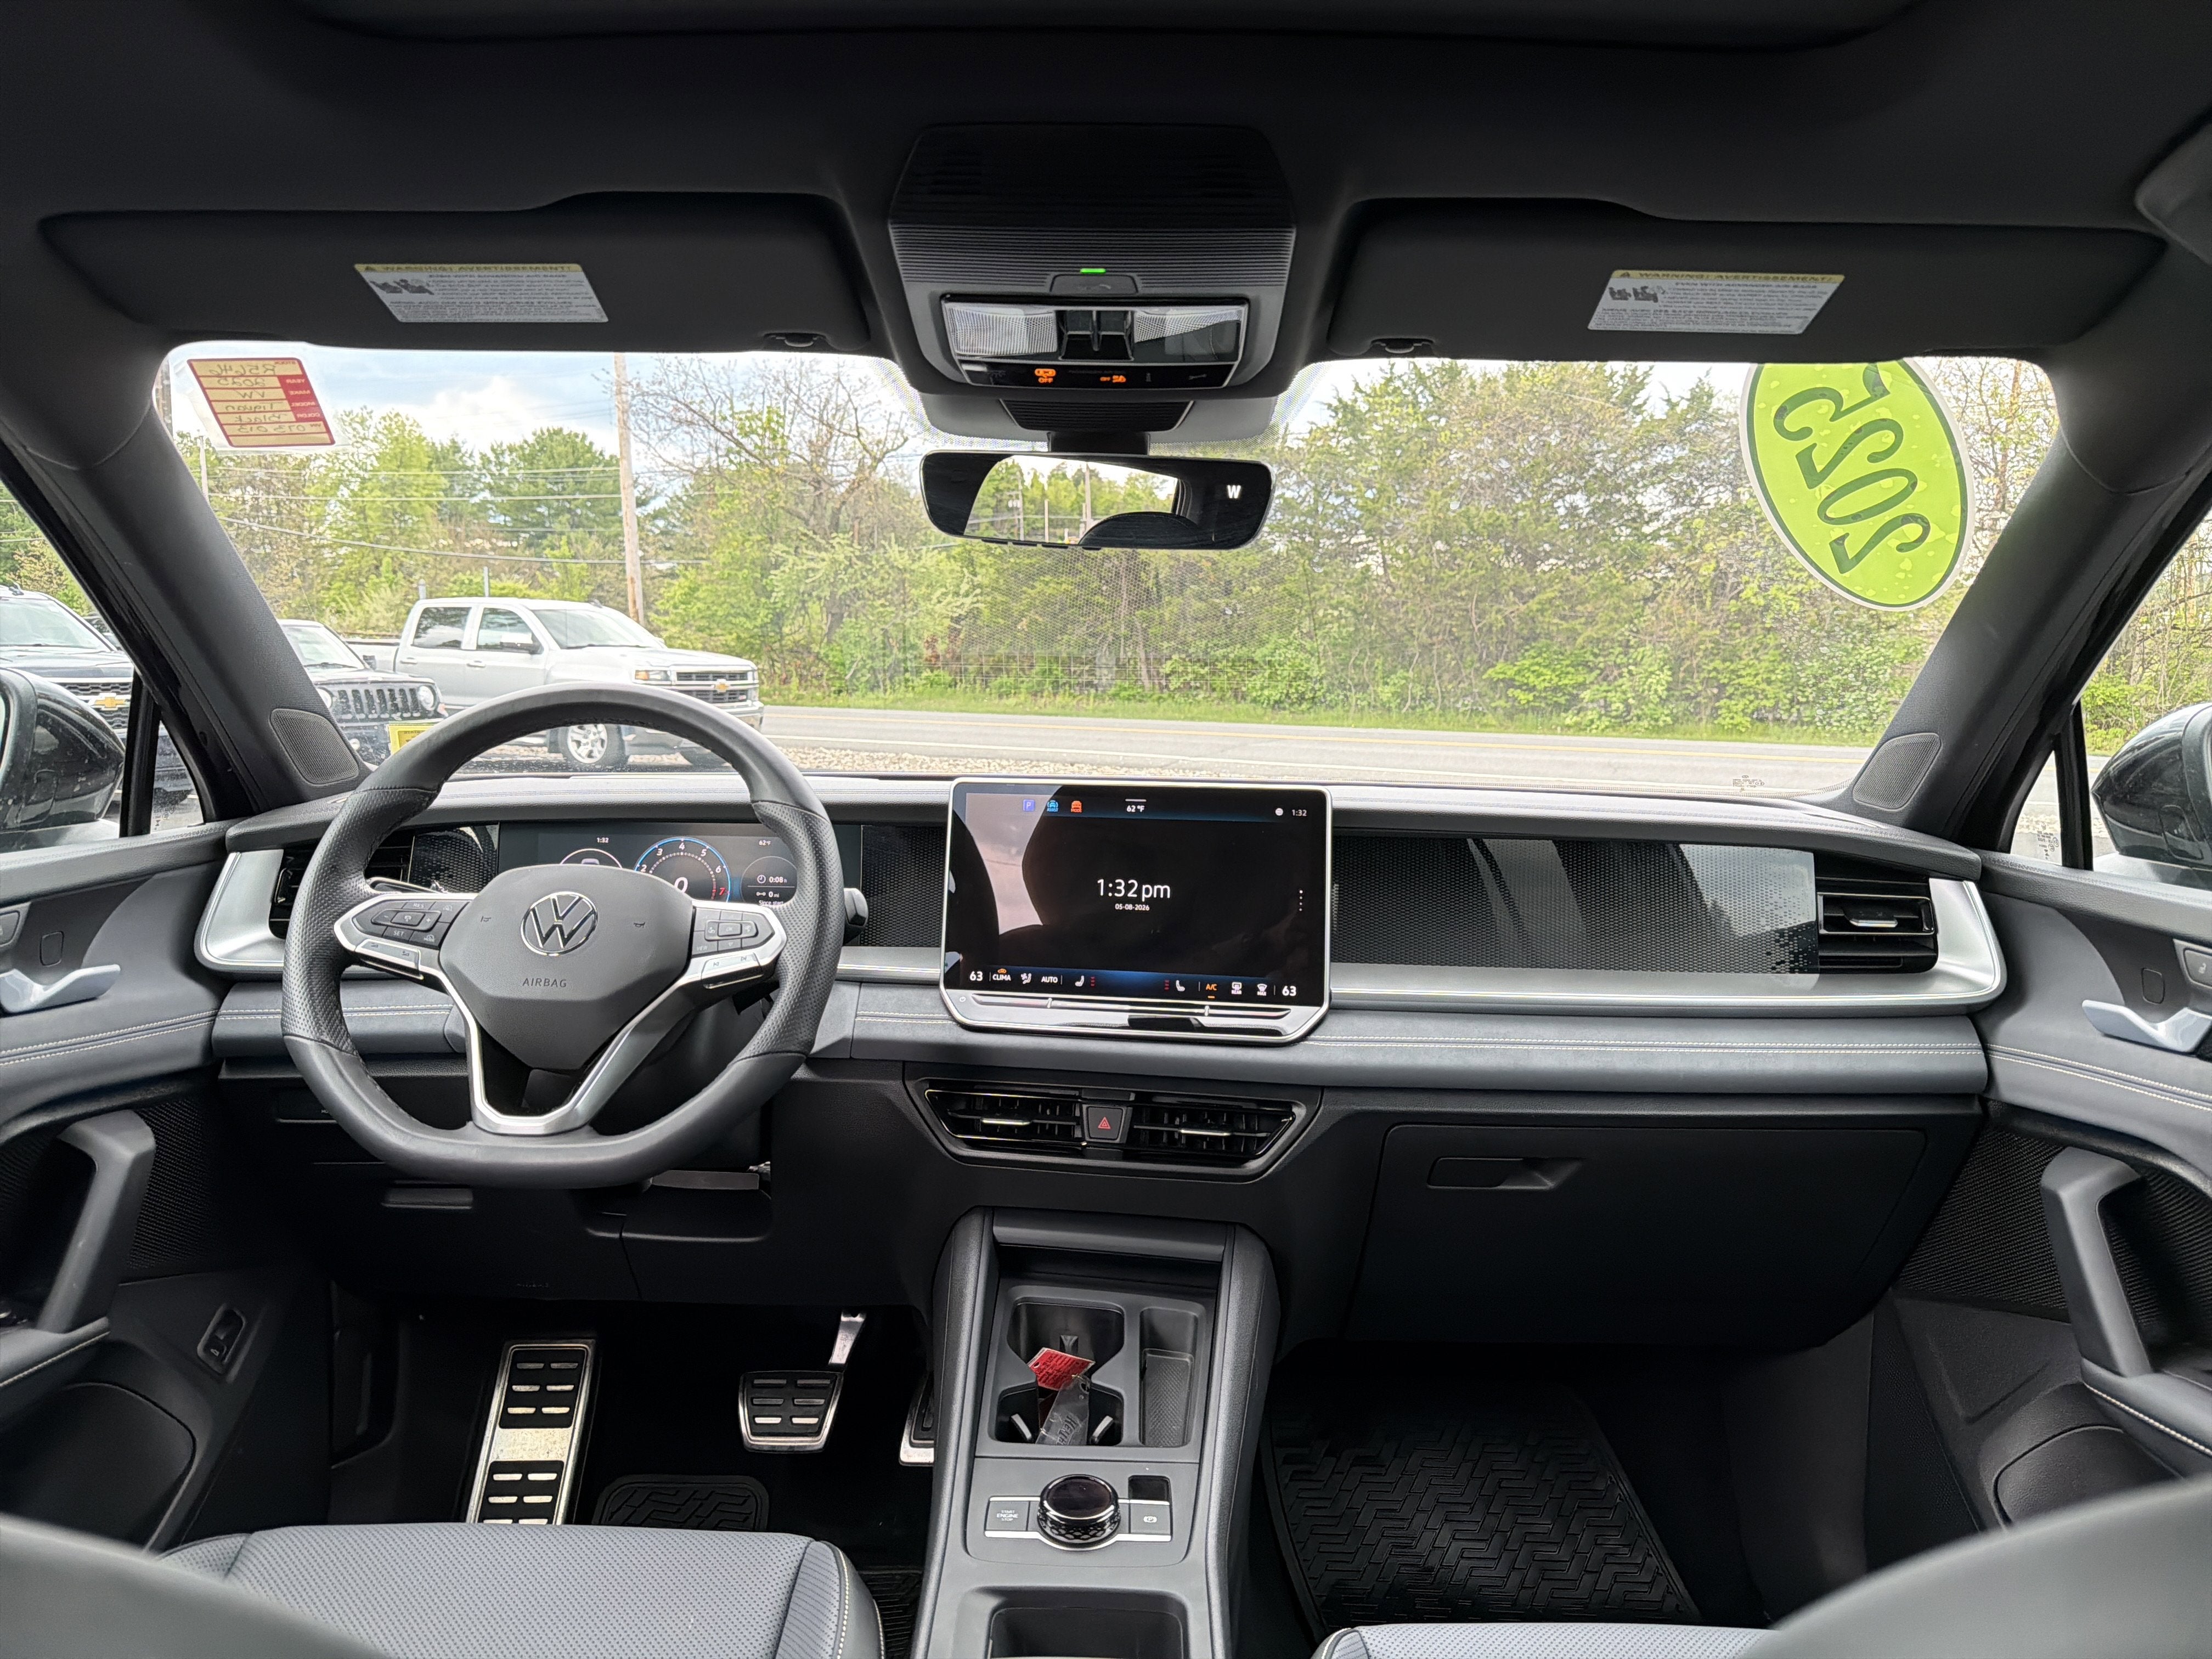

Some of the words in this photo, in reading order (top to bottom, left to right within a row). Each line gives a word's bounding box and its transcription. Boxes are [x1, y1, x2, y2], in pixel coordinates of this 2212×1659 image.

[1227, 484, 1242, 499] W
[701, 849, 707, 857] 5
[640, 864, 647, 872] 2
[715, 865, 721, 873] 6
[969, 971, 983, 981] 63
[522, 978, 567, 988] AIRBAG
[1282, 986, 1296, 996] 63
